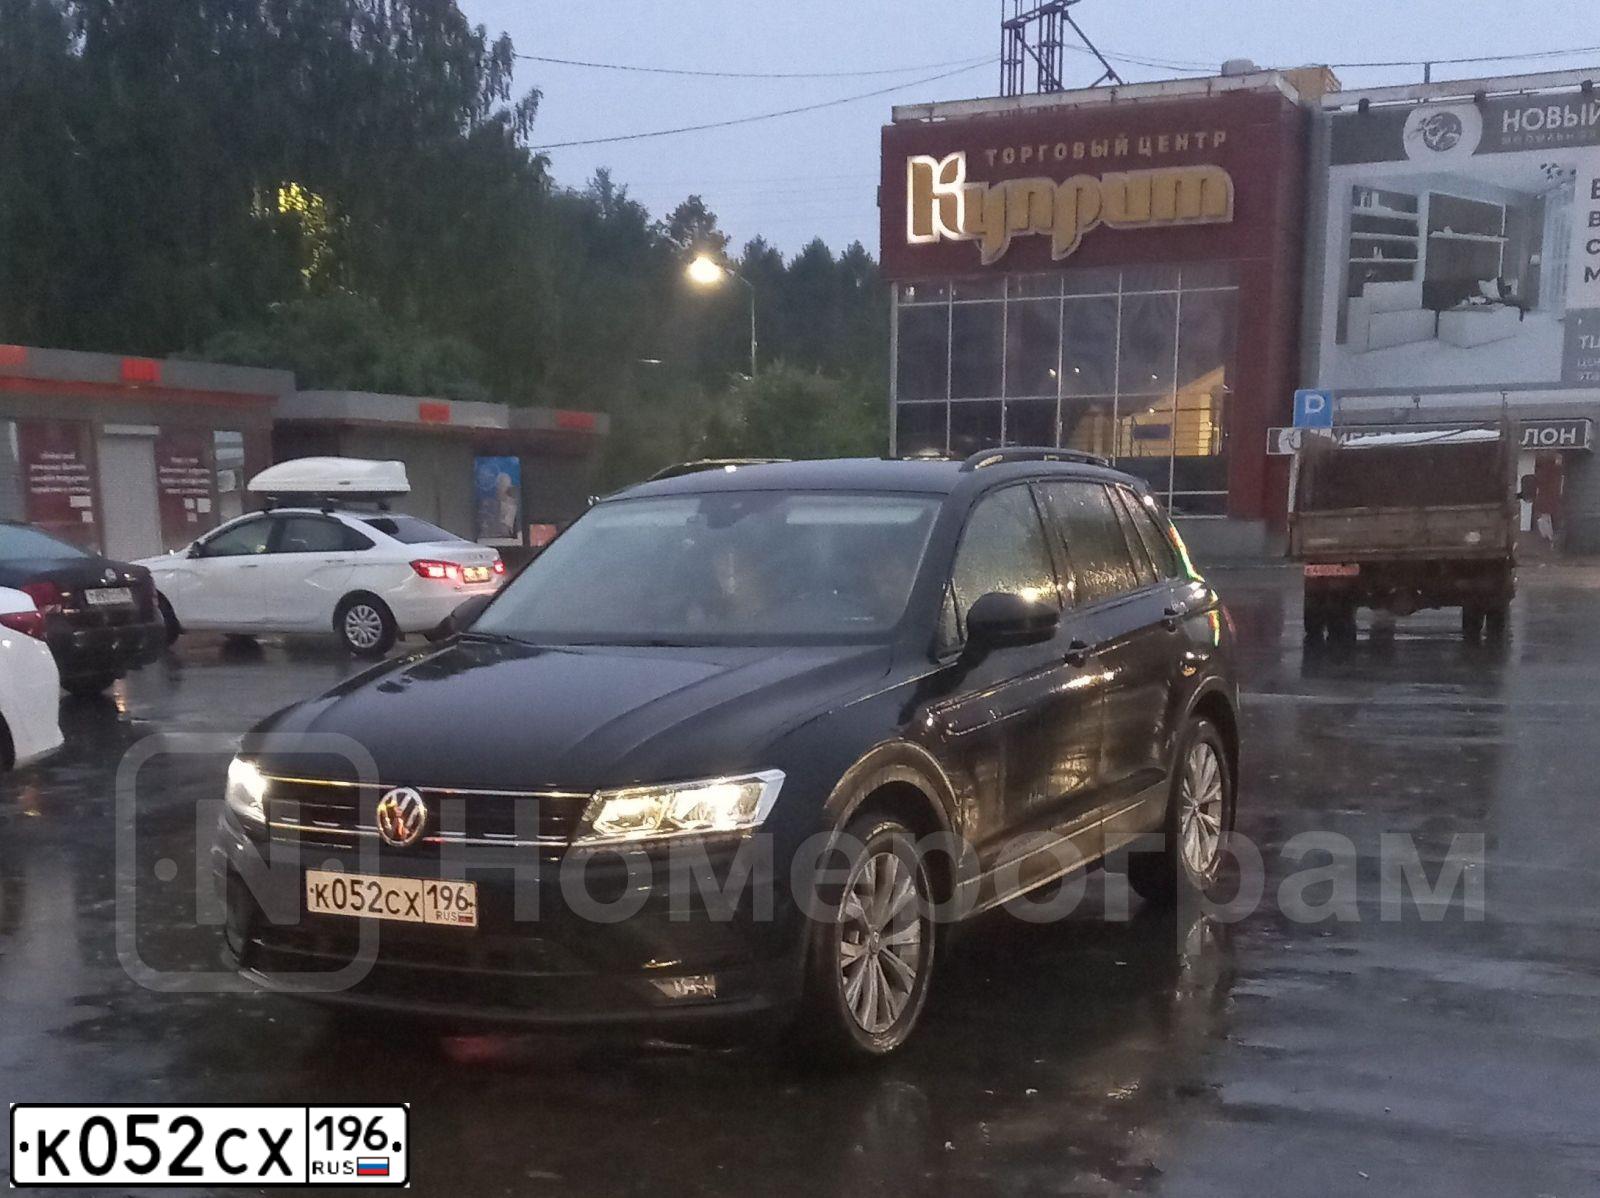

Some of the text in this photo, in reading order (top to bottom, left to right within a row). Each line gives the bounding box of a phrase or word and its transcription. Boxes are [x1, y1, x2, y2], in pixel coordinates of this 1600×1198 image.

[986, 131, 1226, 166] ТОРГОВЫЙ ЦЕНТР
[1305, 394, 1326, 414] P
[315, 878, 469, 917] К052СХ 196
[436, 911, 458, 921] RUS
